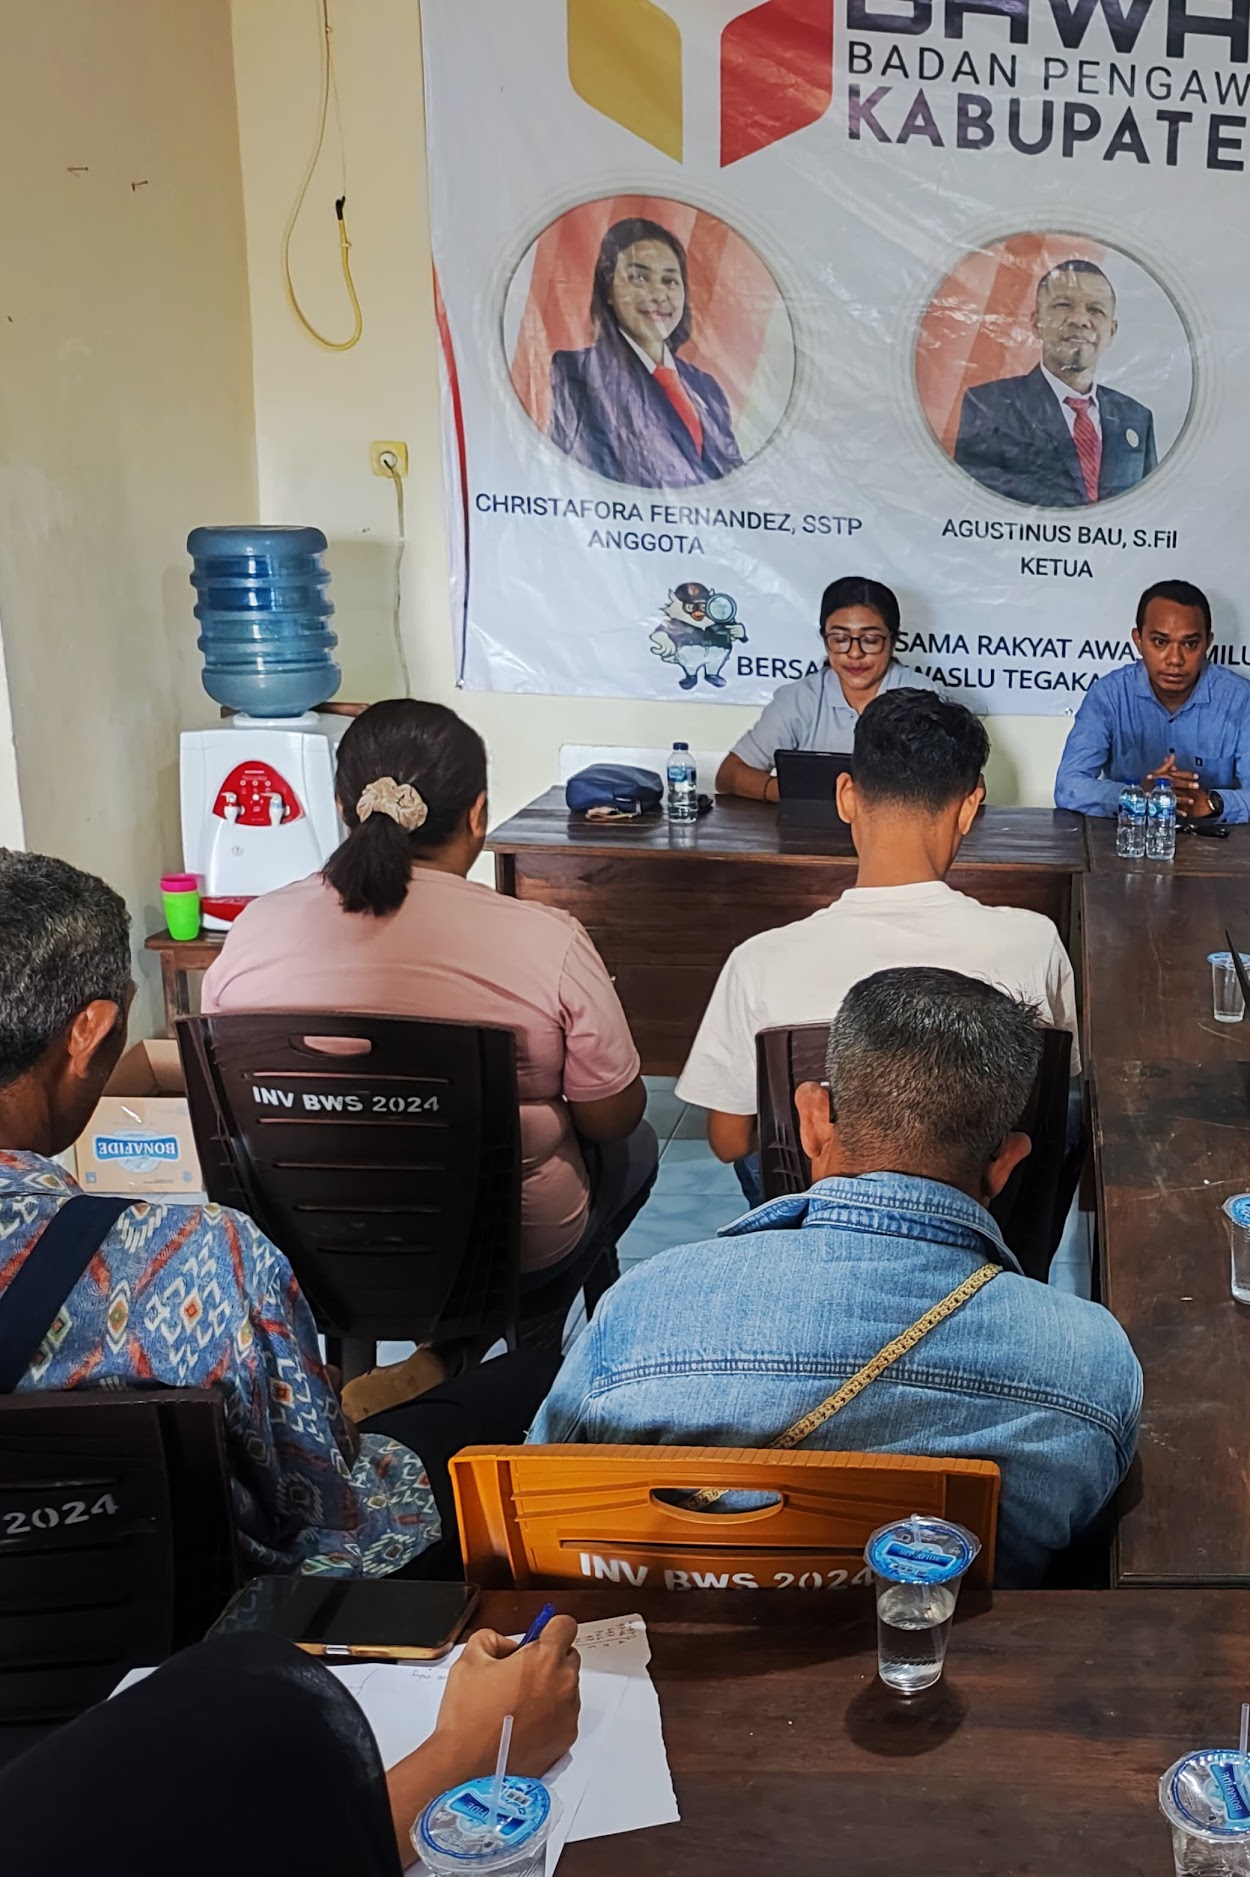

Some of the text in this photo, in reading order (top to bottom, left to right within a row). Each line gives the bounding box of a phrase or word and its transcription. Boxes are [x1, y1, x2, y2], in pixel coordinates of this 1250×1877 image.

[848, 40, 1017, 88] BADAN
[475, 493, 862, 536] CHRISTAFORA FERNANDEZ, SSTP
[588, 530, 705, 555] ANGGOTA
[942, 518, 1071, 543] AGUSTINUS
[1078, 526, 1127, 549] BAU,
[1020, 556, 1094, 578] KETUA
[894, 632, 970, 655] SAMA
[978, 635, 1072, 658] RAKYAT
[1078, 640, 1142, 661] AWA
[737, 656, 819, 680] BERSA
[252, 1086, 440, 1113] INV BWS 2024
[98, 1142, 176, 1155] BONAFIDE
[3, 1493, 119, 1534] 2024
[579, 1552, 875, 1591] INV BWS 2024
